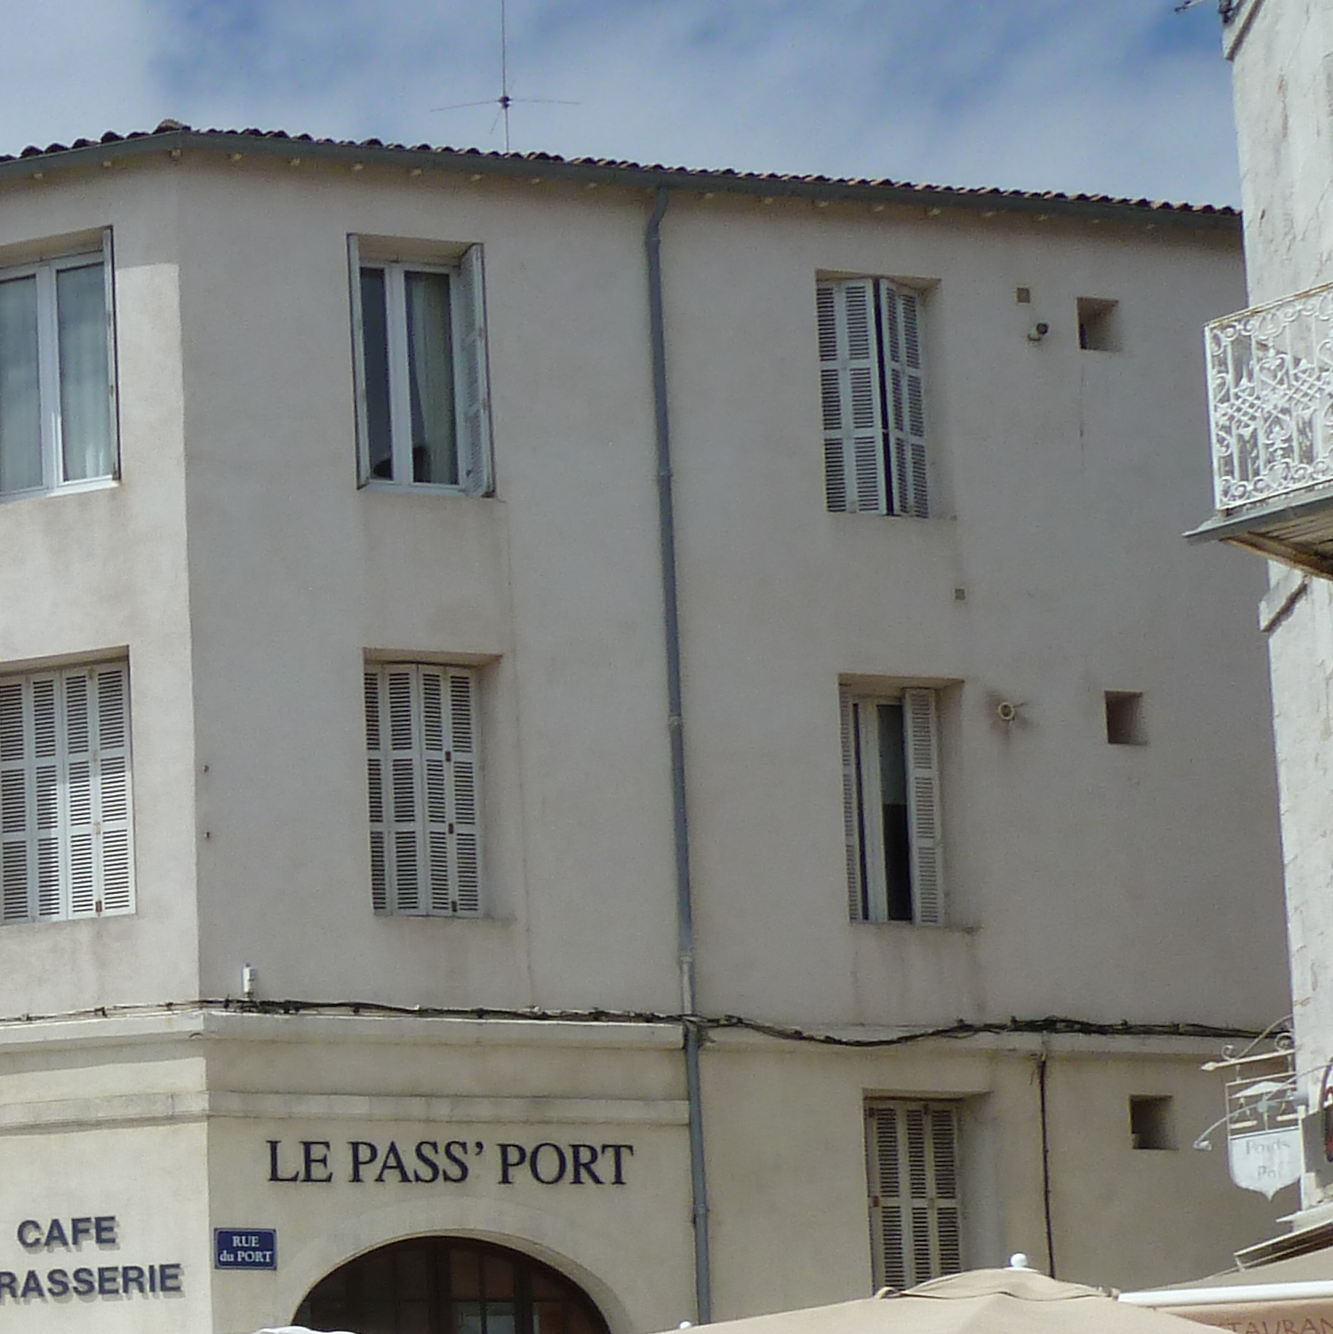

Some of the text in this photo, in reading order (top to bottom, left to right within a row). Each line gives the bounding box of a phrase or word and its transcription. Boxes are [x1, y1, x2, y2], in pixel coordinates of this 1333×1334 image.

[265, 1140, 634, 1185] LE PASS' PORT
[16, 1215, 117, 1249] CAFE
[232, 1235, 260, 1248] RUE
[219, 1249, 273, 1263] du PORT
